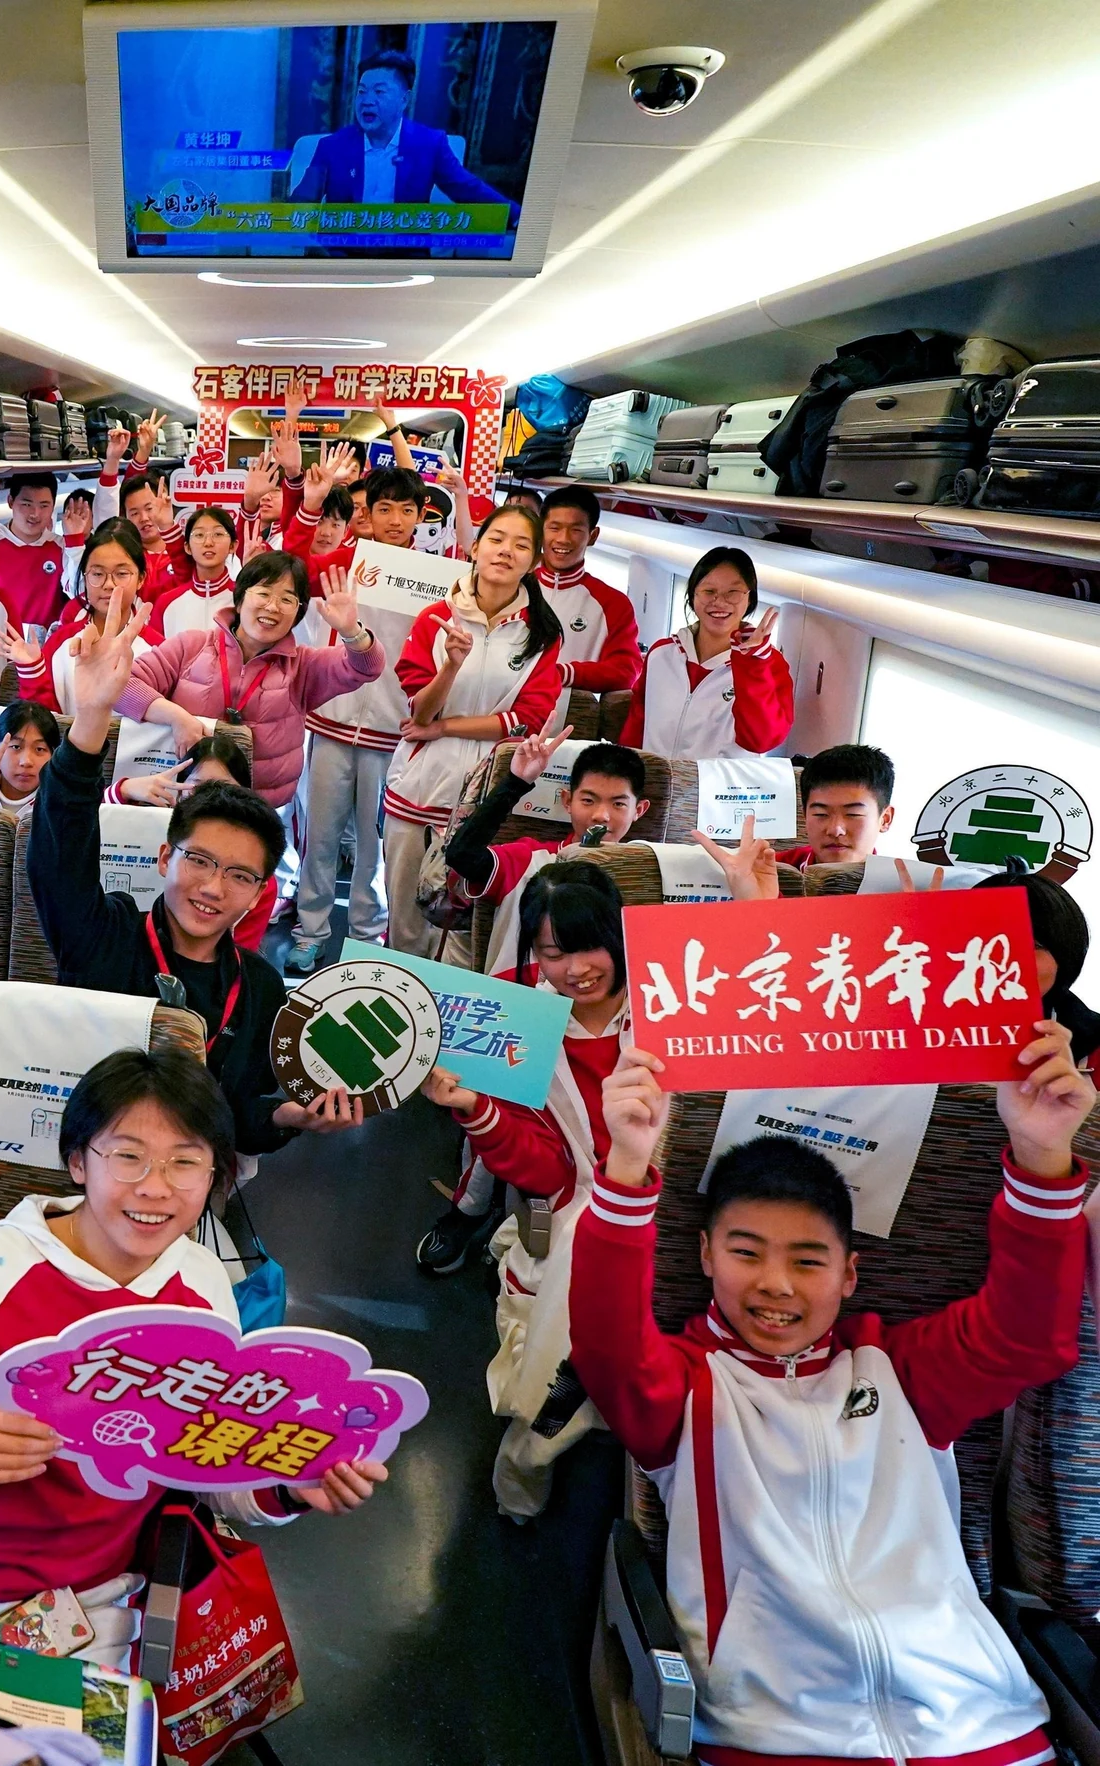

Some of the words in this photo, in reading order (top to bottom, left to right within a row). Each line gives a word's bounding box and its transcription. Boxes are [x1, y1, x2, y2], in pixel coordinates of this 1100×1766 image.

[184, 133, 231, 148] 黄华坤
[143, 192, 219, 217] 大国品牌
[194, 366, 323, 400] 石客伴同行
[334, 366, 467, 400] 研学探丹江
[938, 773, 1084, 819] 北京二十中学
[639, 925, 1029, 1025] 北京青年报
[340, 968, 432, 1067] 北京二十中学
[665, 1033, 784, 1057] BEIJING
[800, 1029, 907, 1052] YOUTH
[924, 1024, 1022, 1049] DAILY
[309, 1060, 332, 1084] 1951
[65, 1346, 293, 1416] 行走的
[167, 1411, 335, 1478] 课程
[164, 1613, 269, 1695] 厚奶皮子酸奶
